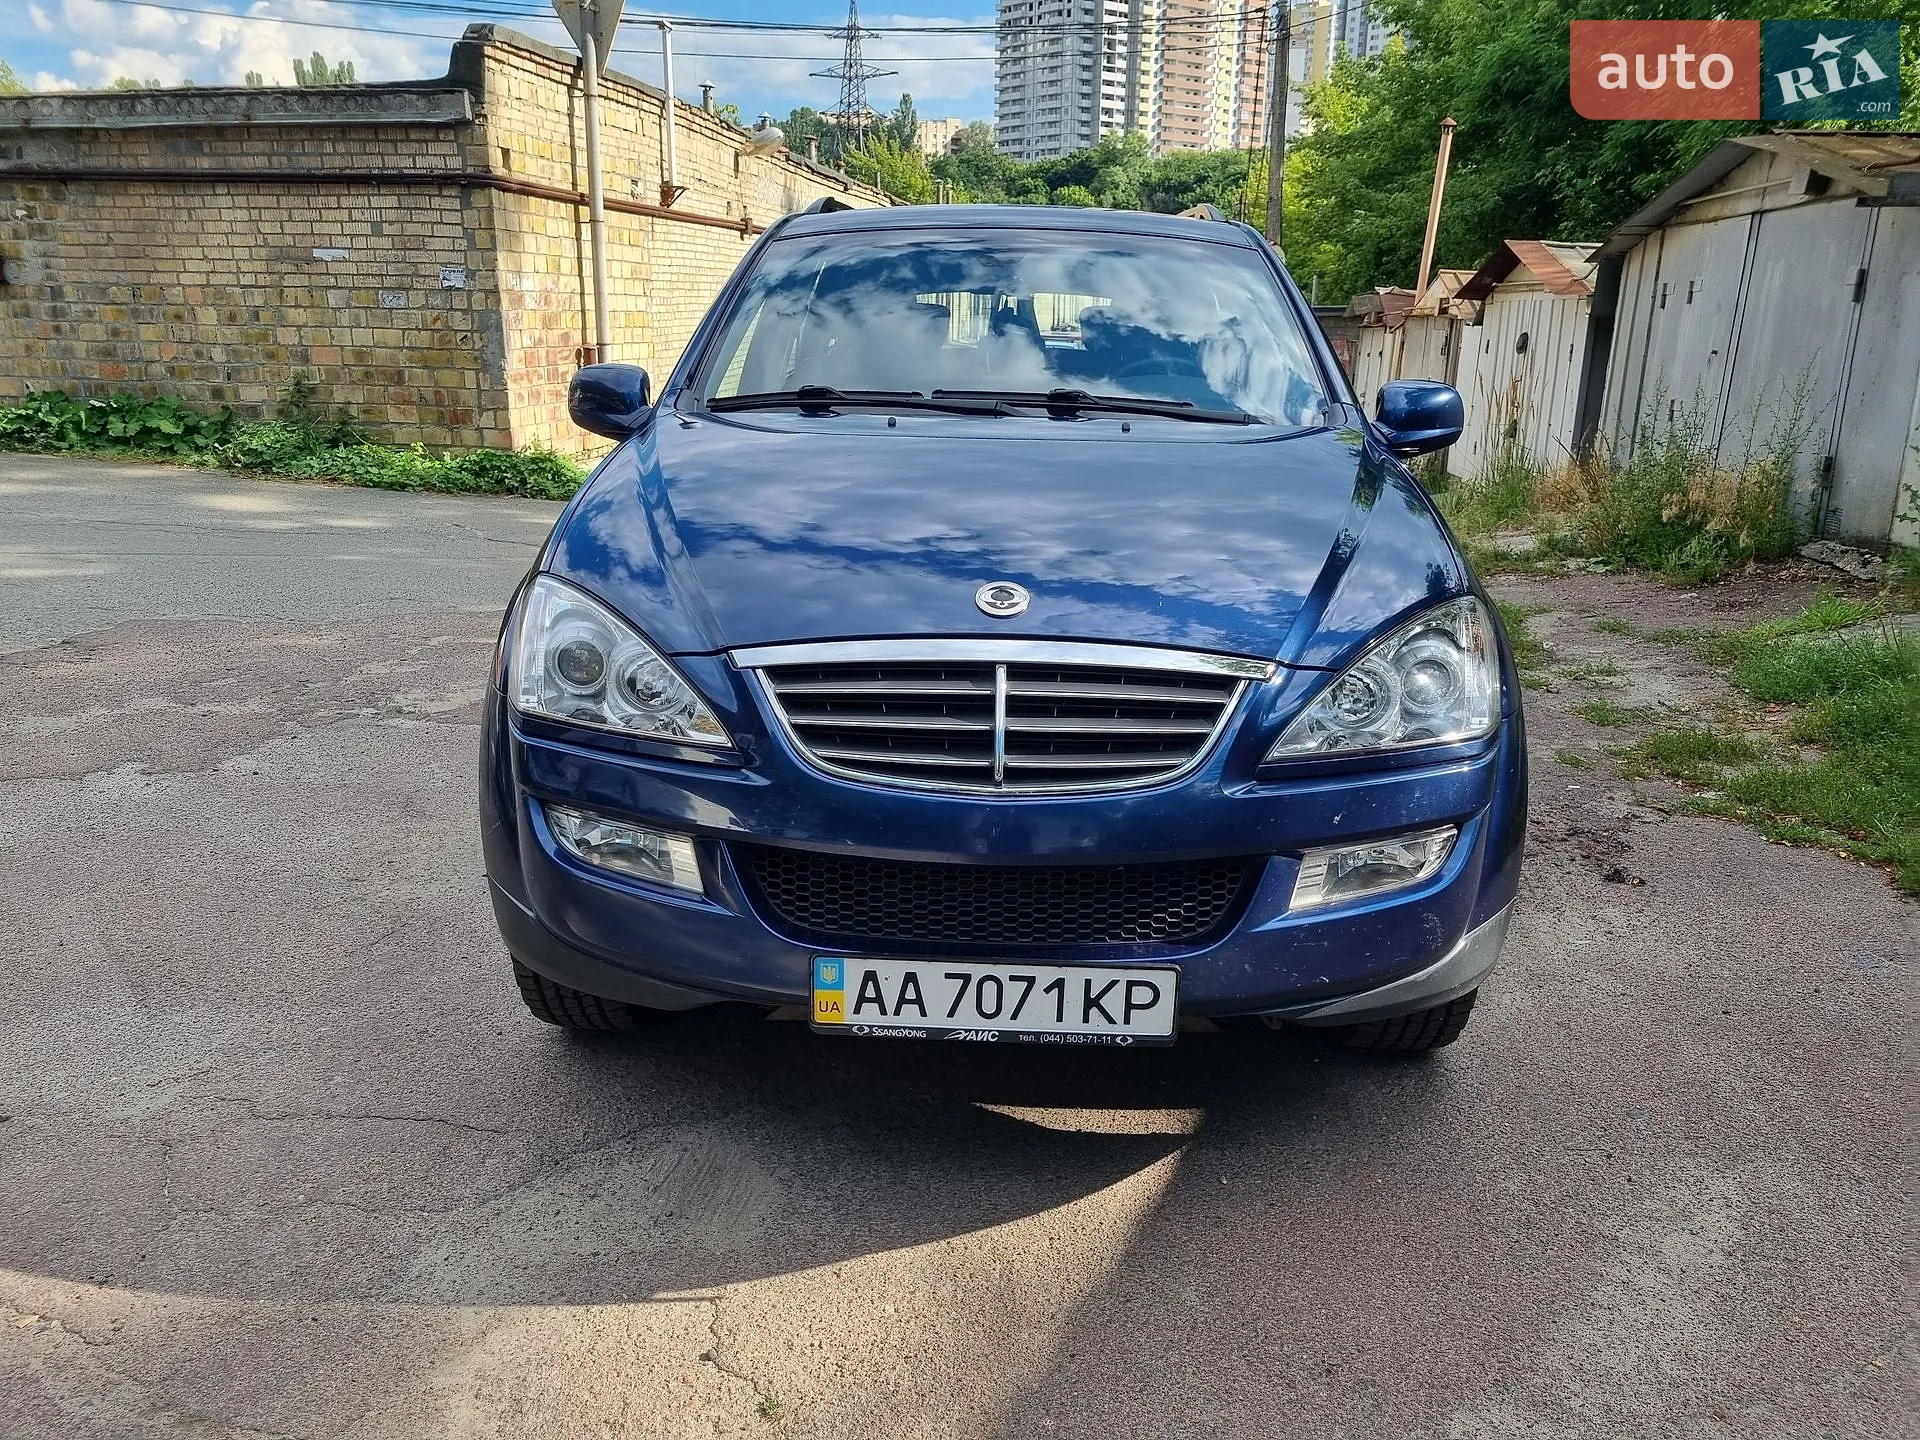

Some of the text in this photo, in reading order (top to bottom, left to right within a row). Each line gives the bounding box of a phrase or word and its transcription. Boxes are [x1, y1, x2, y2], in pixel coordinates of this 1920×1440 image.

[853, 970, 1161, 1026] AA 7071 KP
[819, 1000, 841, 1013] UA
[1018, 1034, 1112, 1045] тел. (044) 503-71-11
